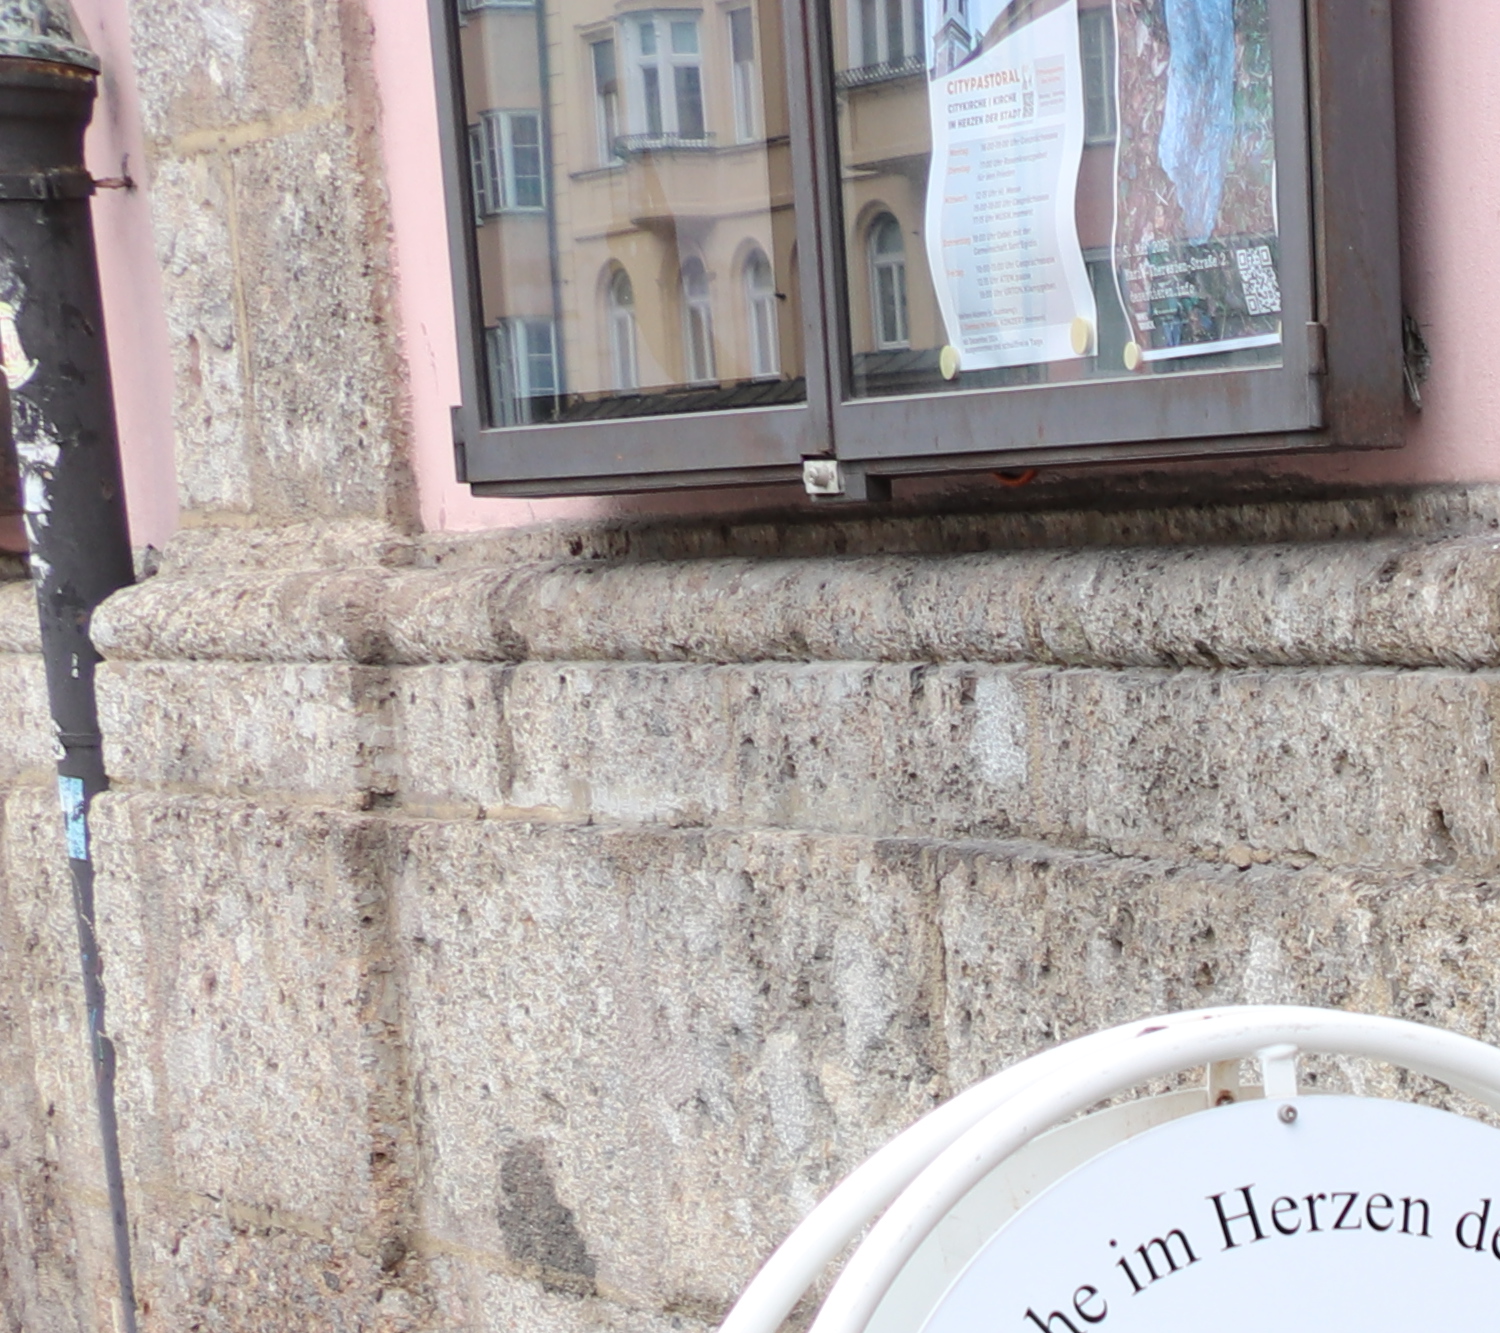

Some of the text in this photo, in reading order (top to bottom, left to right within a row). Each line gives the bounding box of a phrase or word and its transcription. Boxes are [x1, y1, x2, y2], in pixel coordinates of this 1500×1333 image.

[947, 69, 1020, 95] CITYPASTORAL
[993, 92, 1017, 105] KIRCHE
[958, 116, 983, 129] HERZEN
[985, 112, 998, 124] DER
[1000, 108, 1021, 121] STADT
[1108, 1226, 1200, 1296] im
[1205, 1183, 1434, 1252] Herzen
